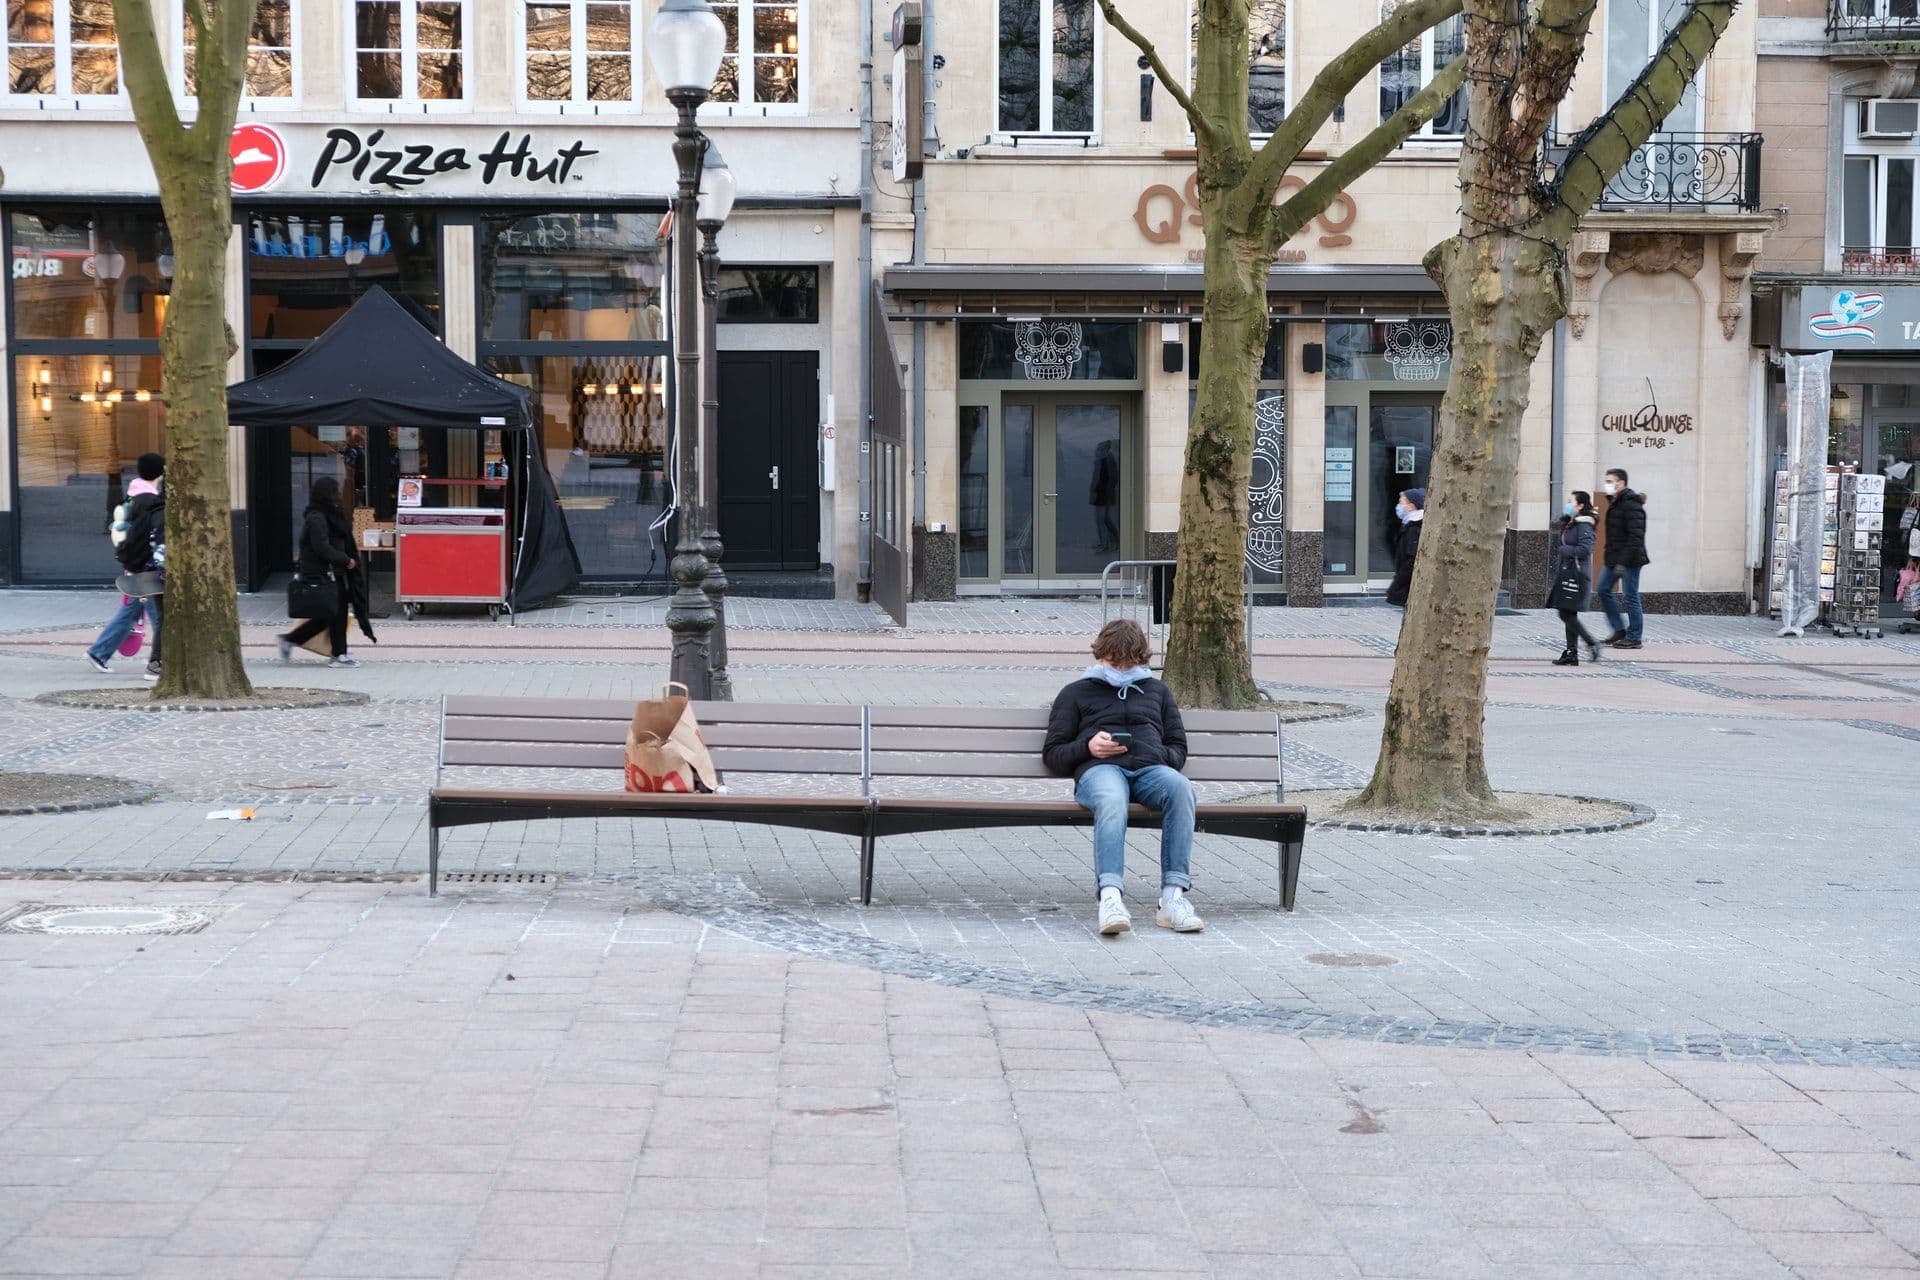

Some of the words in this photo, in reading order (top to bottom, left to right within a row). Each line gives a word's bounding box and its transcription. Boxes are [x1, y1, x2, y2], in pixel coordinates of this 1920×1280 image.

[310, 128, 472, 189] Pizza
[478, 130, 600, 185] Hut
[1602, 414, 1637, 433] CHILL
